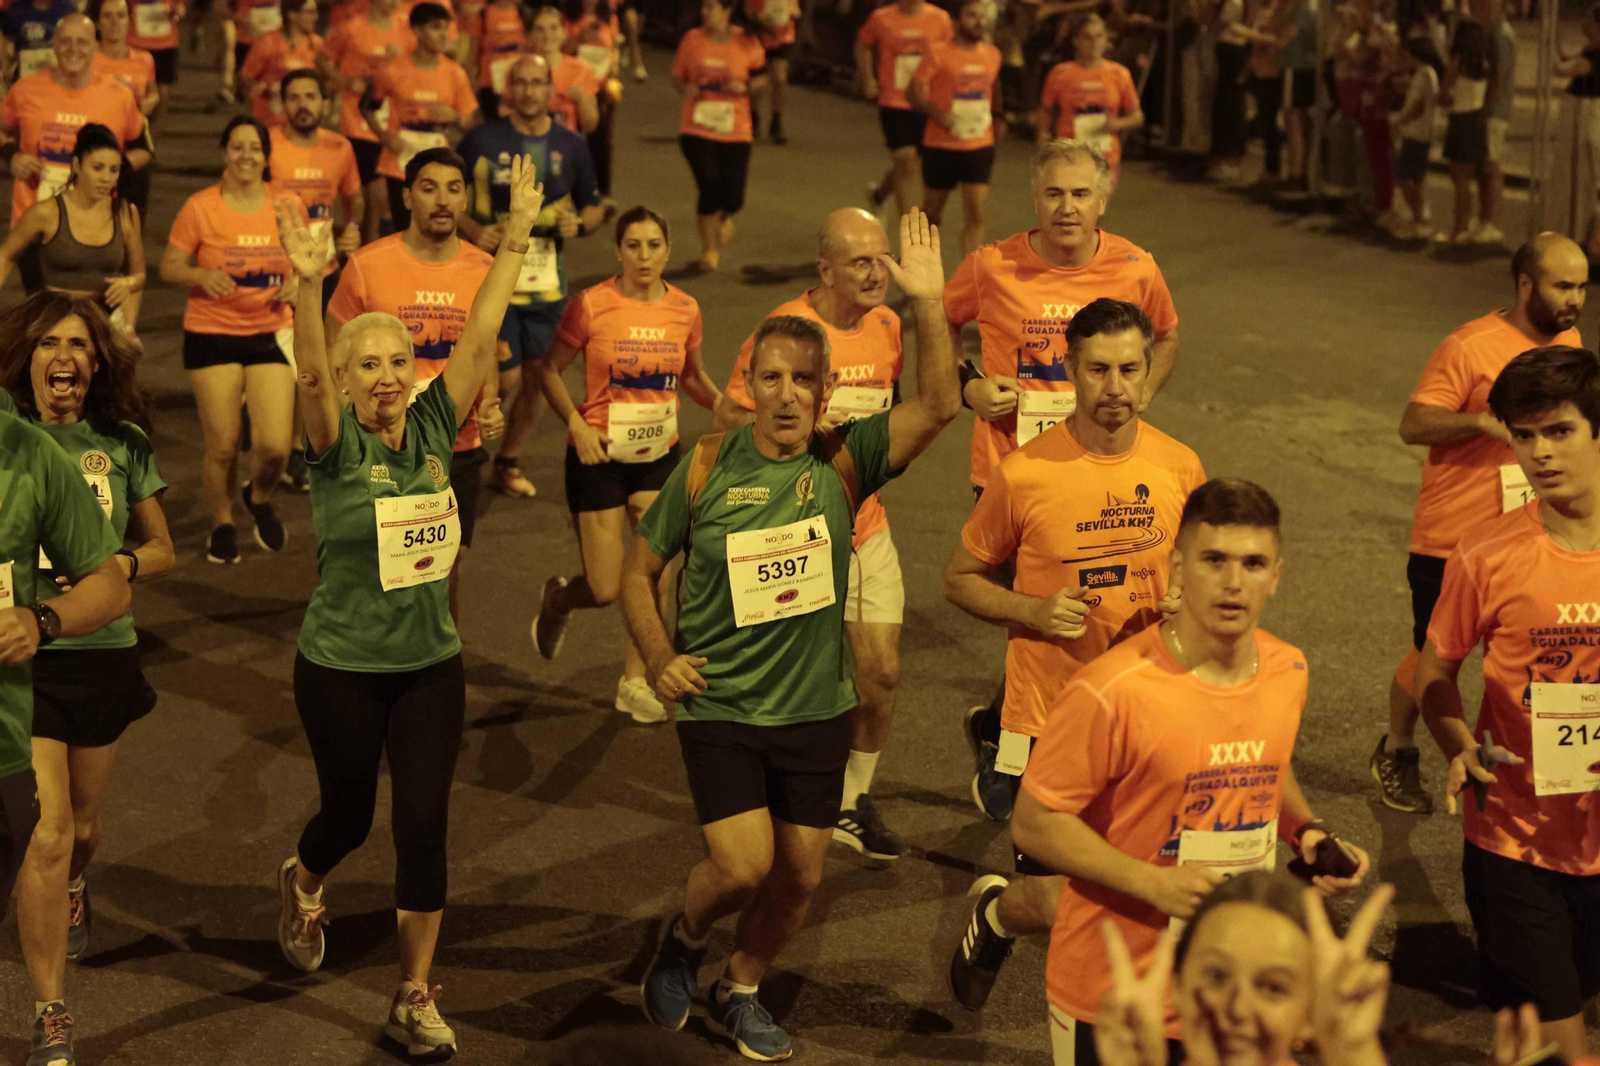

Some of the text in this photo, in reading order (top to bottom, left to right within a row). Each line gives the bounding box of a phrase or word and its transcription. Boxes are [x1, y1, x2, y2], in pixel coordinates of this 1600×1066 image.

[415, 290, 456, 306] XXXV
[403, 312, 467, 322] GUADALQUIVIR
[433, 306, 467, 314] NOCTURNA
[1042, 303, 1080, 319] XXX
[629, 326, 667, 340] XXXV
[1027, 326, 1068, 335] GUADAL
[1025, 341, 1045, 349] KH7
[839, 363, 876, 381] XXXV
[627, 425, 664, 441] 9208
[727, 492, 769, 500] NOCTURNA
[1101, 507, 1155, 518] NOCTURNA
[1076, 519, 1126, 532] SEVILLA
[403, 524, 447, 548] 5430
[757, 555, 808, 583] 5397
[778, 592, 795, 601] KH7
[1529, 627, 1581, 636] CARRERA
[1208, 740, 1265, 766] XXXV
[1186, 764, 1279, 781] CARRERA NOCTURNA
[1190, 774, 1278, 793] GUADALQUIVIR
